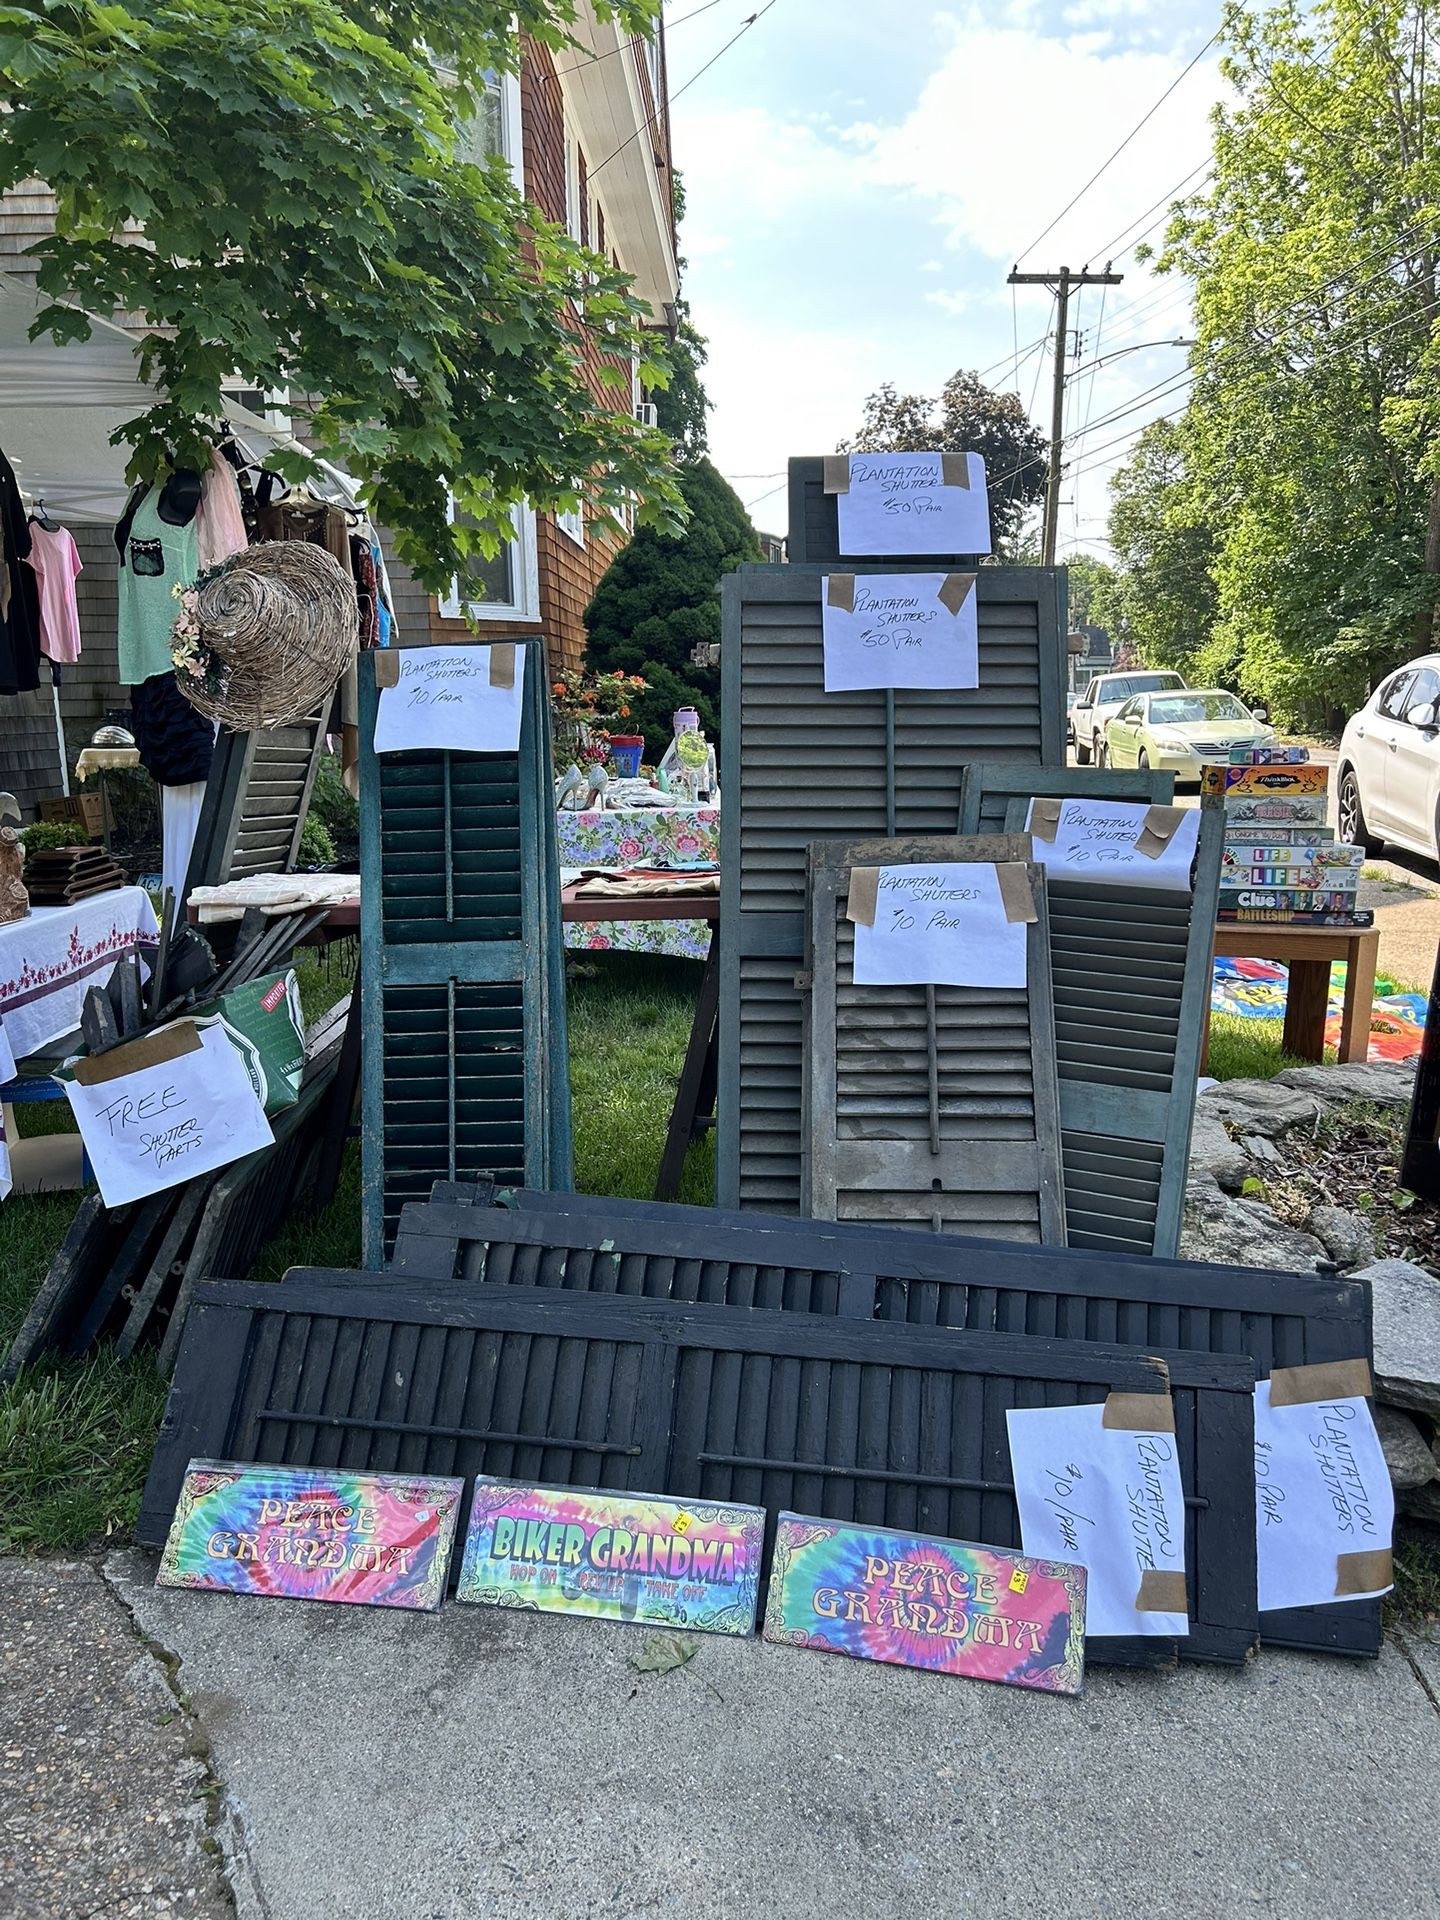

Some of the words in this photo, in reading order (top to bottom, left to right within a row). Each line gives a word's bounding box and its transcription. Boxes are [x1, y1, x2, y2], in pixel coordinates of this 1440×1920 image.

[850, 463, 939, 483] PLANTATION
[913, 497, 943, 515] PAIR
[854, 588, 919, 612] PLANTATION
[877, 611, 938, 628] SHUTTERS
[892, 628, 922, 650] PAIR
[400, 657, 472, 679] PLANTATION
[424, 668, 481, 682] SHUTTERS
[1063, 806, 1138, 829] PLANTATION
[1097, 849, 1134, 862] PAIR
[1254, 849, 1290, 861] LIFE
[878, 872, 946, 892] PLANTATION
[1252, 867, 1300, 885] LIFE
[910, 889, 982, 902] SHUTTERS
[1238, 892, 1276, 907] Clue
[926, 910, 961, 931] PAIR
[1238, 909, 1295, 921] BATTLESHIP
[263, 981, 287, 1010] IMPORTED
[95, 1085, 187, 1136] FREE
[155, 1135, 203, 1168] PARTS
[1318, 1405, 1377, 1535] PLANTATION
[1309, 1434, 1354, 1534] SHUTTERS
[1134, 1435, 1176, 1557] PLANTATION
[1255, 1482, 1286, 1526] PAIR
[257, 1498, 378, 1535] PEACE
[207, 1531, 413, 1575] GRANDMA
[490, 1516, 586, 1566] BIKER
[588, 1526, 736, 1586] GRANDMA
[510, 1564, 537, 1582] HOP
[540, 1568, 557, 1585] ON
[579, 1572, 602, 1590] REV
[606, 1574, 625, 1592] UP
[644, 1579, 680, 1597] TAKE
[681, 1584, 708, 1601] OFF
[863, 1555, 999, 1605] PEACE
[812, 1588, 1043, 1653] GRANDMA
